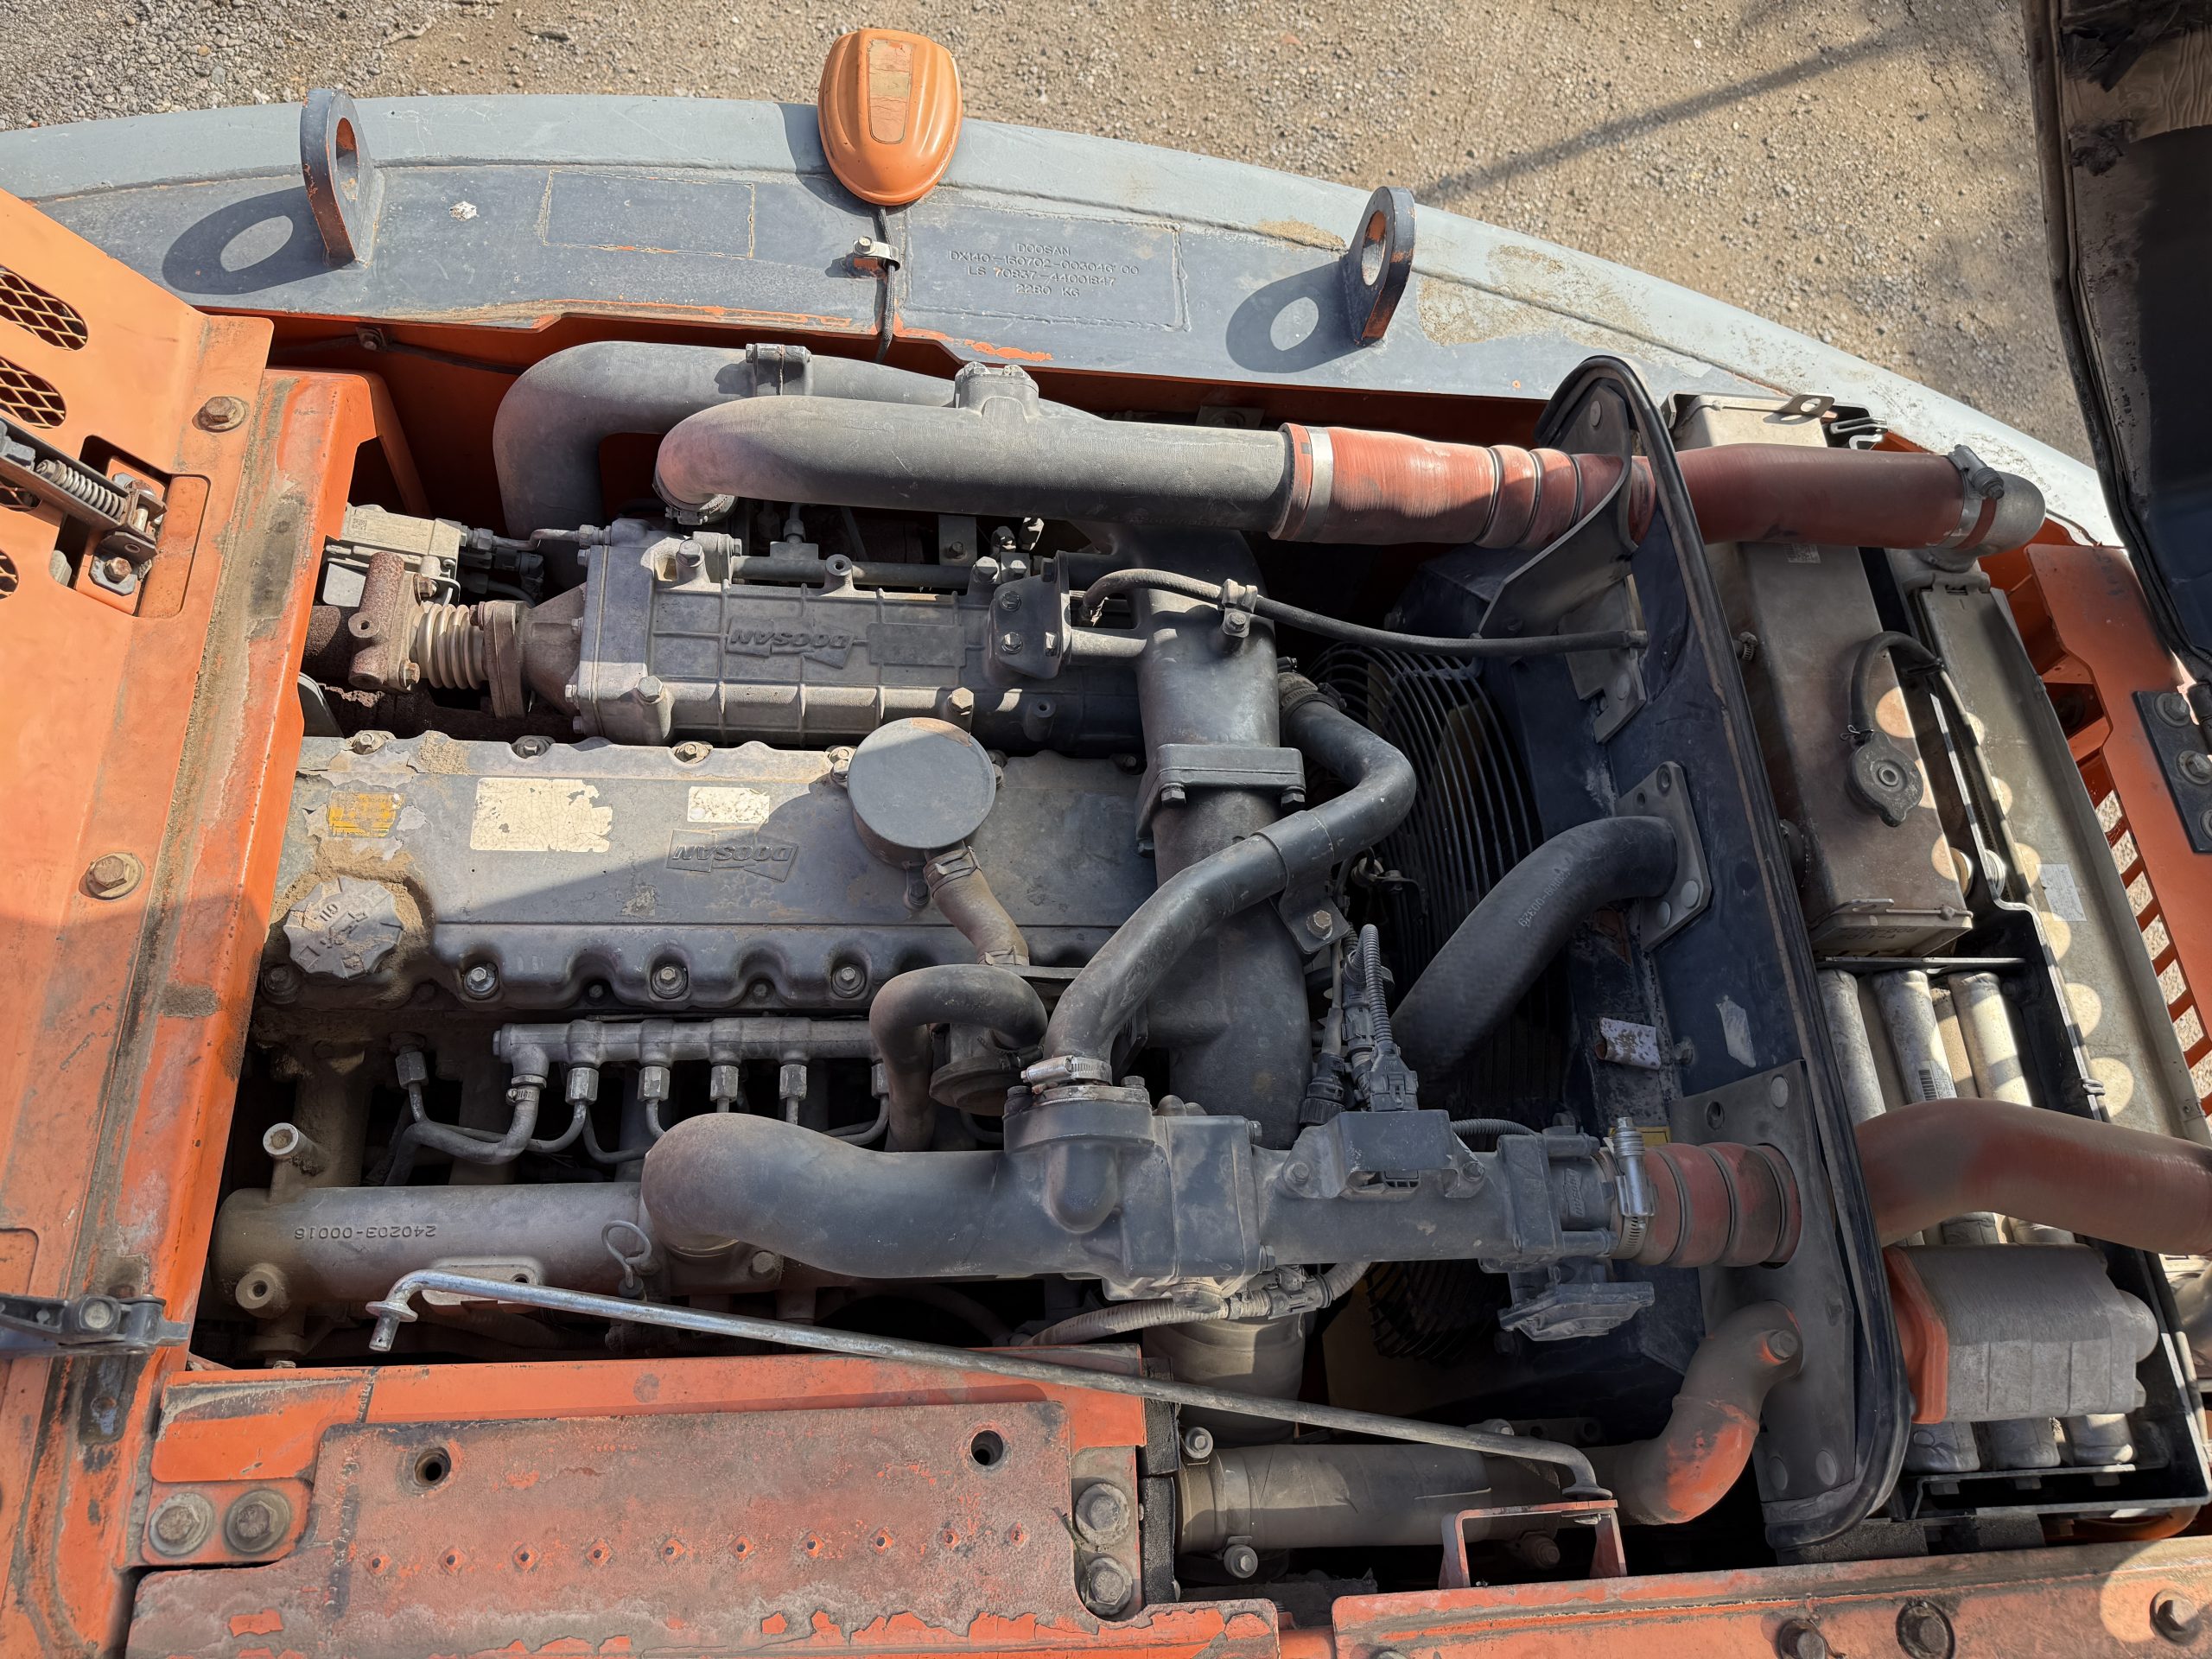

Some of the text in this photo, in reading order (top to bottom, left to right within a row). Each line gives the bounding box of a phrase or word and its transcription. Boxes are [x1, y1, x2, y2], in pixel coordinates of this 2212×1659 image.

[1016, 242, 1071, 257] DOOSAN
[967, 264, 987, 276] LS
[1060, 286, 1080, 298] KG
[729, 630, 850, 650] DOOSAN
[671, 845, 793, 861] DOOSAN
[294, 1225, 437, 1241] 240203-00016
